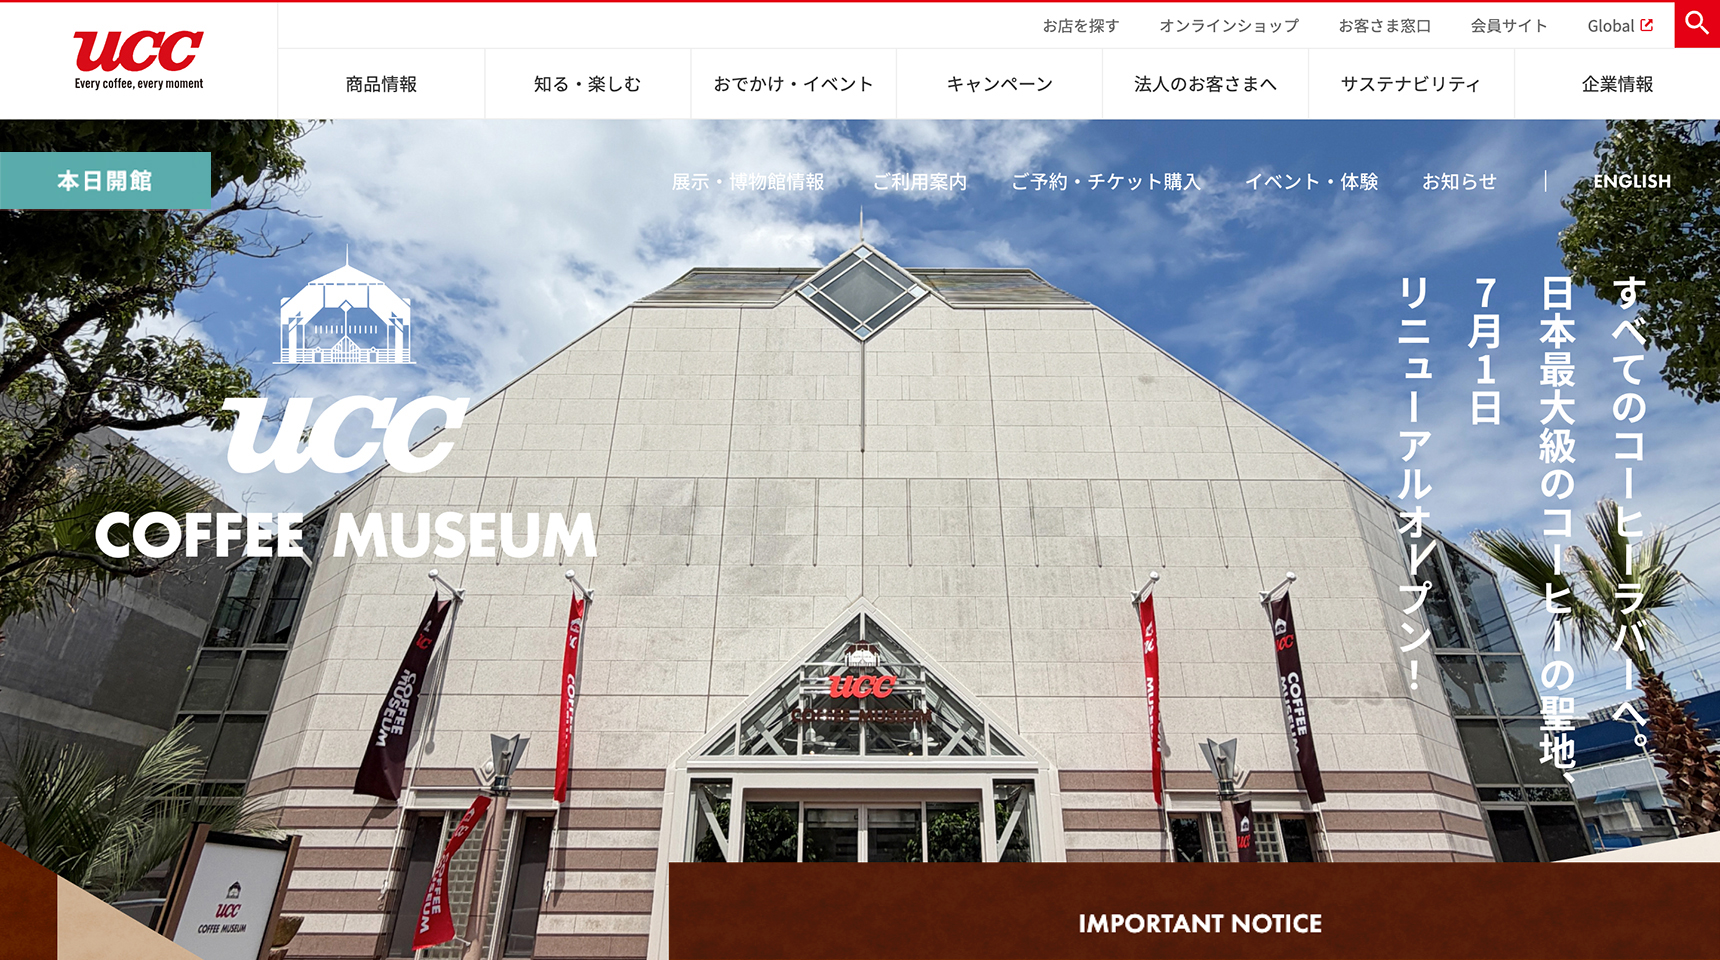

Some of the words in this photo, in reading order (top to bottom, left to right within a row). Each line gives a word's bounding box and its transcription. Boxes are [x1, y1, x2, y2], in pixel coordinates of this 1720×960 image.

[1287, 671, 1308, 737] COFFEE
[198, 924, 220, 934] COFFEE
[221, 924, 247, 933] MUSEUM
